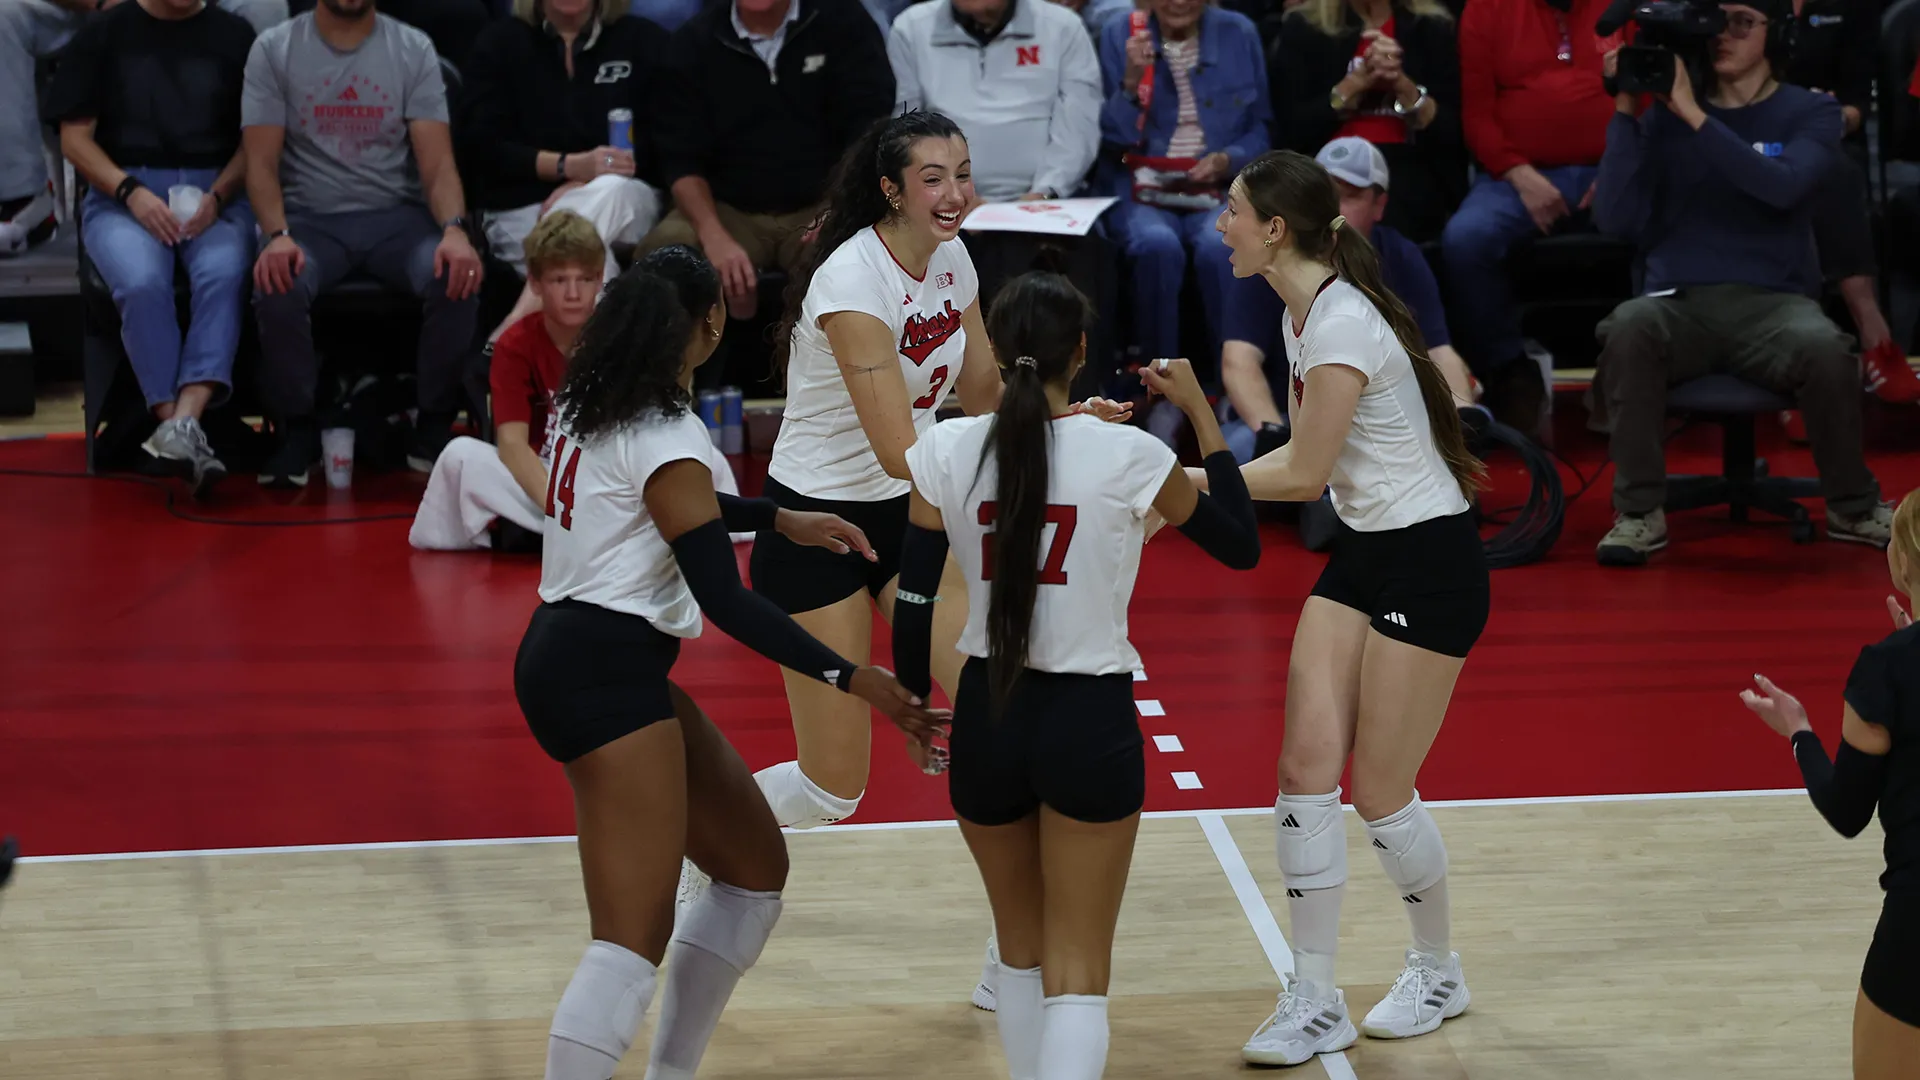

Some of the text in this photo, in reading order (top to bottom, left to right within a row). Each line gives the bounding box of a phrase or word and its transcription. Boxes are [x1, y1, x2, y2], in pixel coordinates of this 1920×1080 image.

[594, 61, 632, 84] P
[1015, 45, 1041, 67] N
[912, 364, 949, 410] 3
[545, 434, 582, 531] 14
